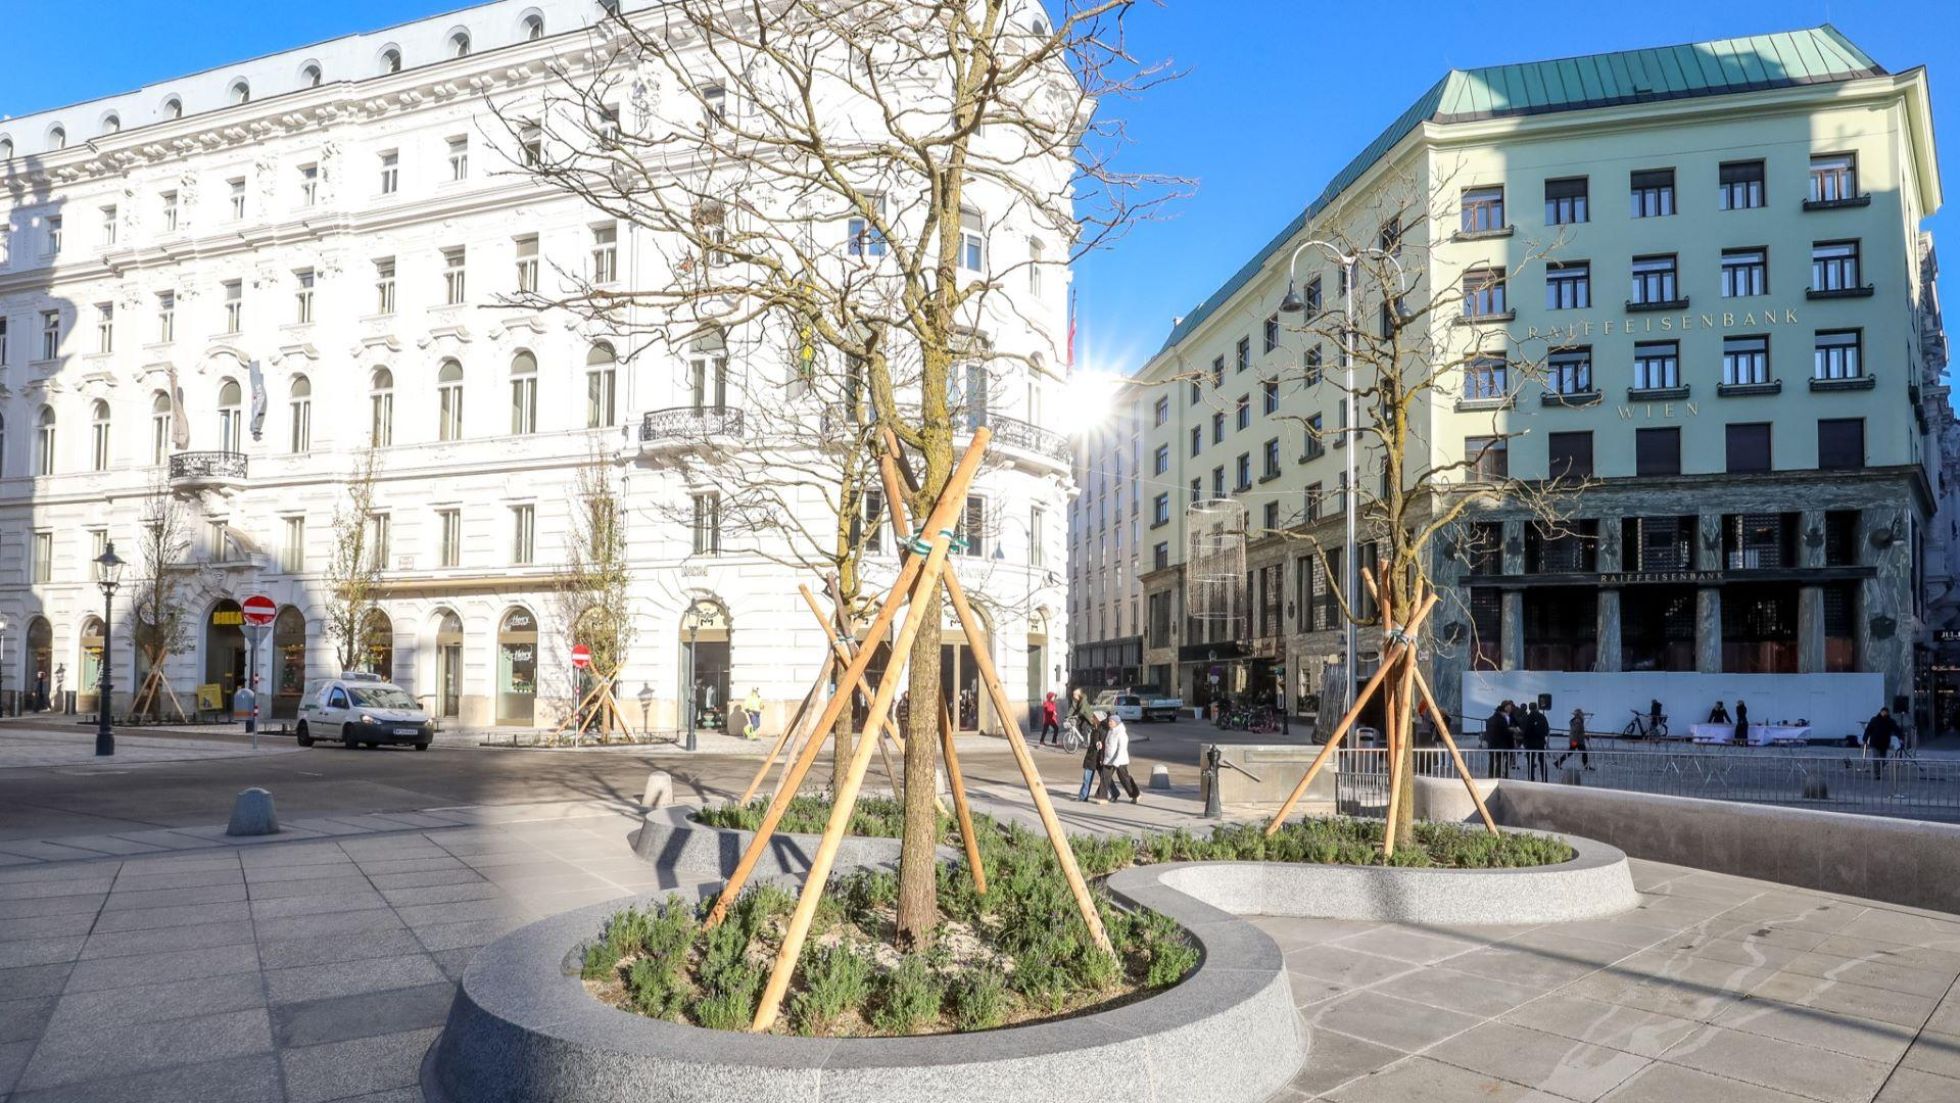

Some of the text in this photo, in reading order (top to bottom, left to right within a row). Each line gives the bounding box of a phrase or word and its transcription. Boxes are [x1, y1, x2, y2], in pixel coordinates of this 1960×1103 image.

[1528, 308, 1799, 338] RAIFFEISENBANK
[1617, 402, 1699, 420] WIEN
[1600, 571, 1724, 583] RAIFFEISENBANK
